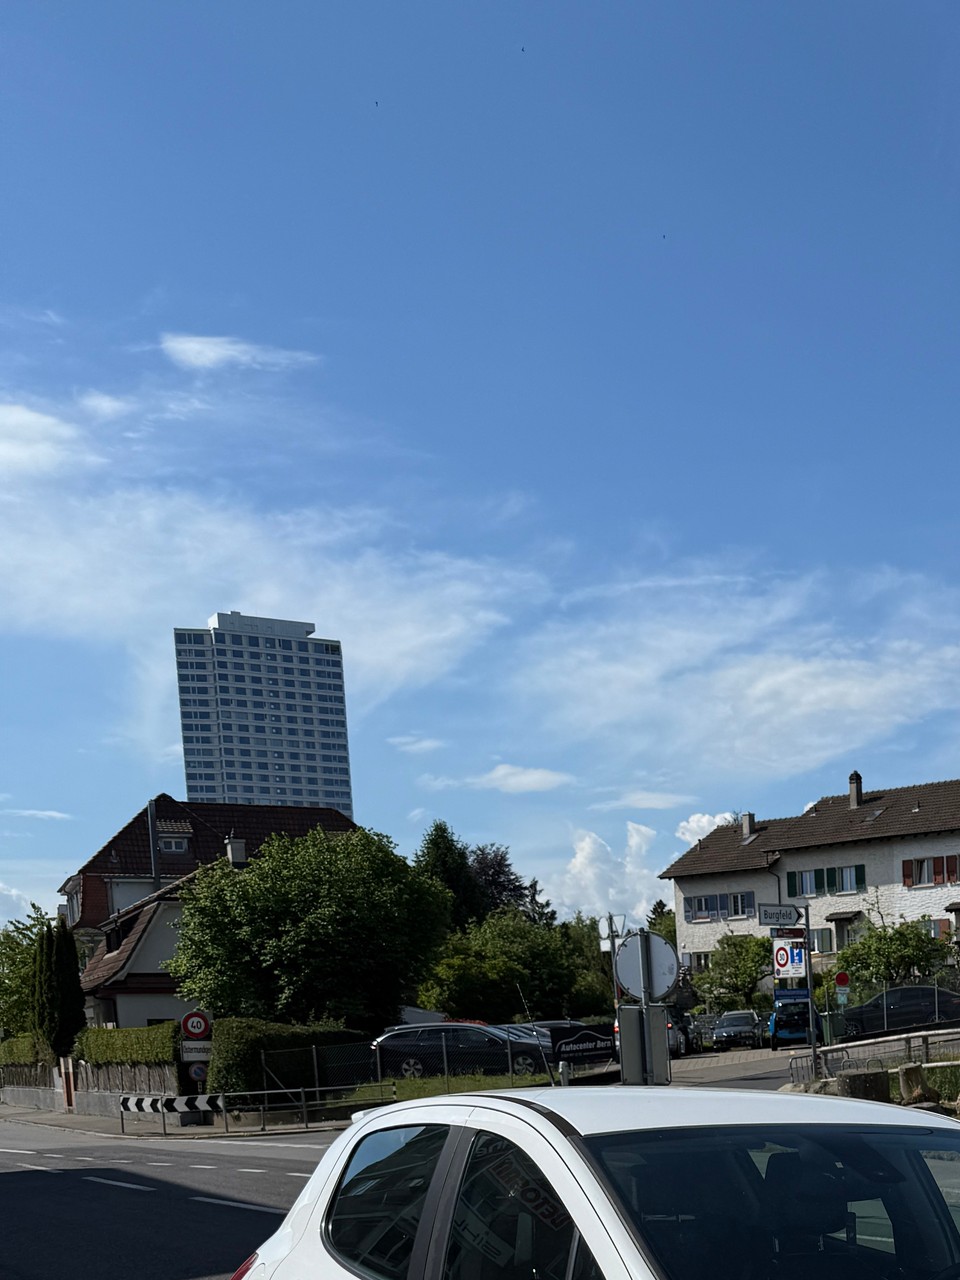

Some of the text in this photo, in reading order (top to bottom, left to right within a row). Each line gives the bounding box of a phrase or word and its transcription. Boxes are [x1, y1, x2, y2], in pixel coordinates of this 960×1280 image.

[764, 910, 792, 922] Burgfeld
[779, 953, 785, 961] 30
[191, 1021, 202, 1030] 40
[561, 1040, 611, 1051] Autocenter Bern
